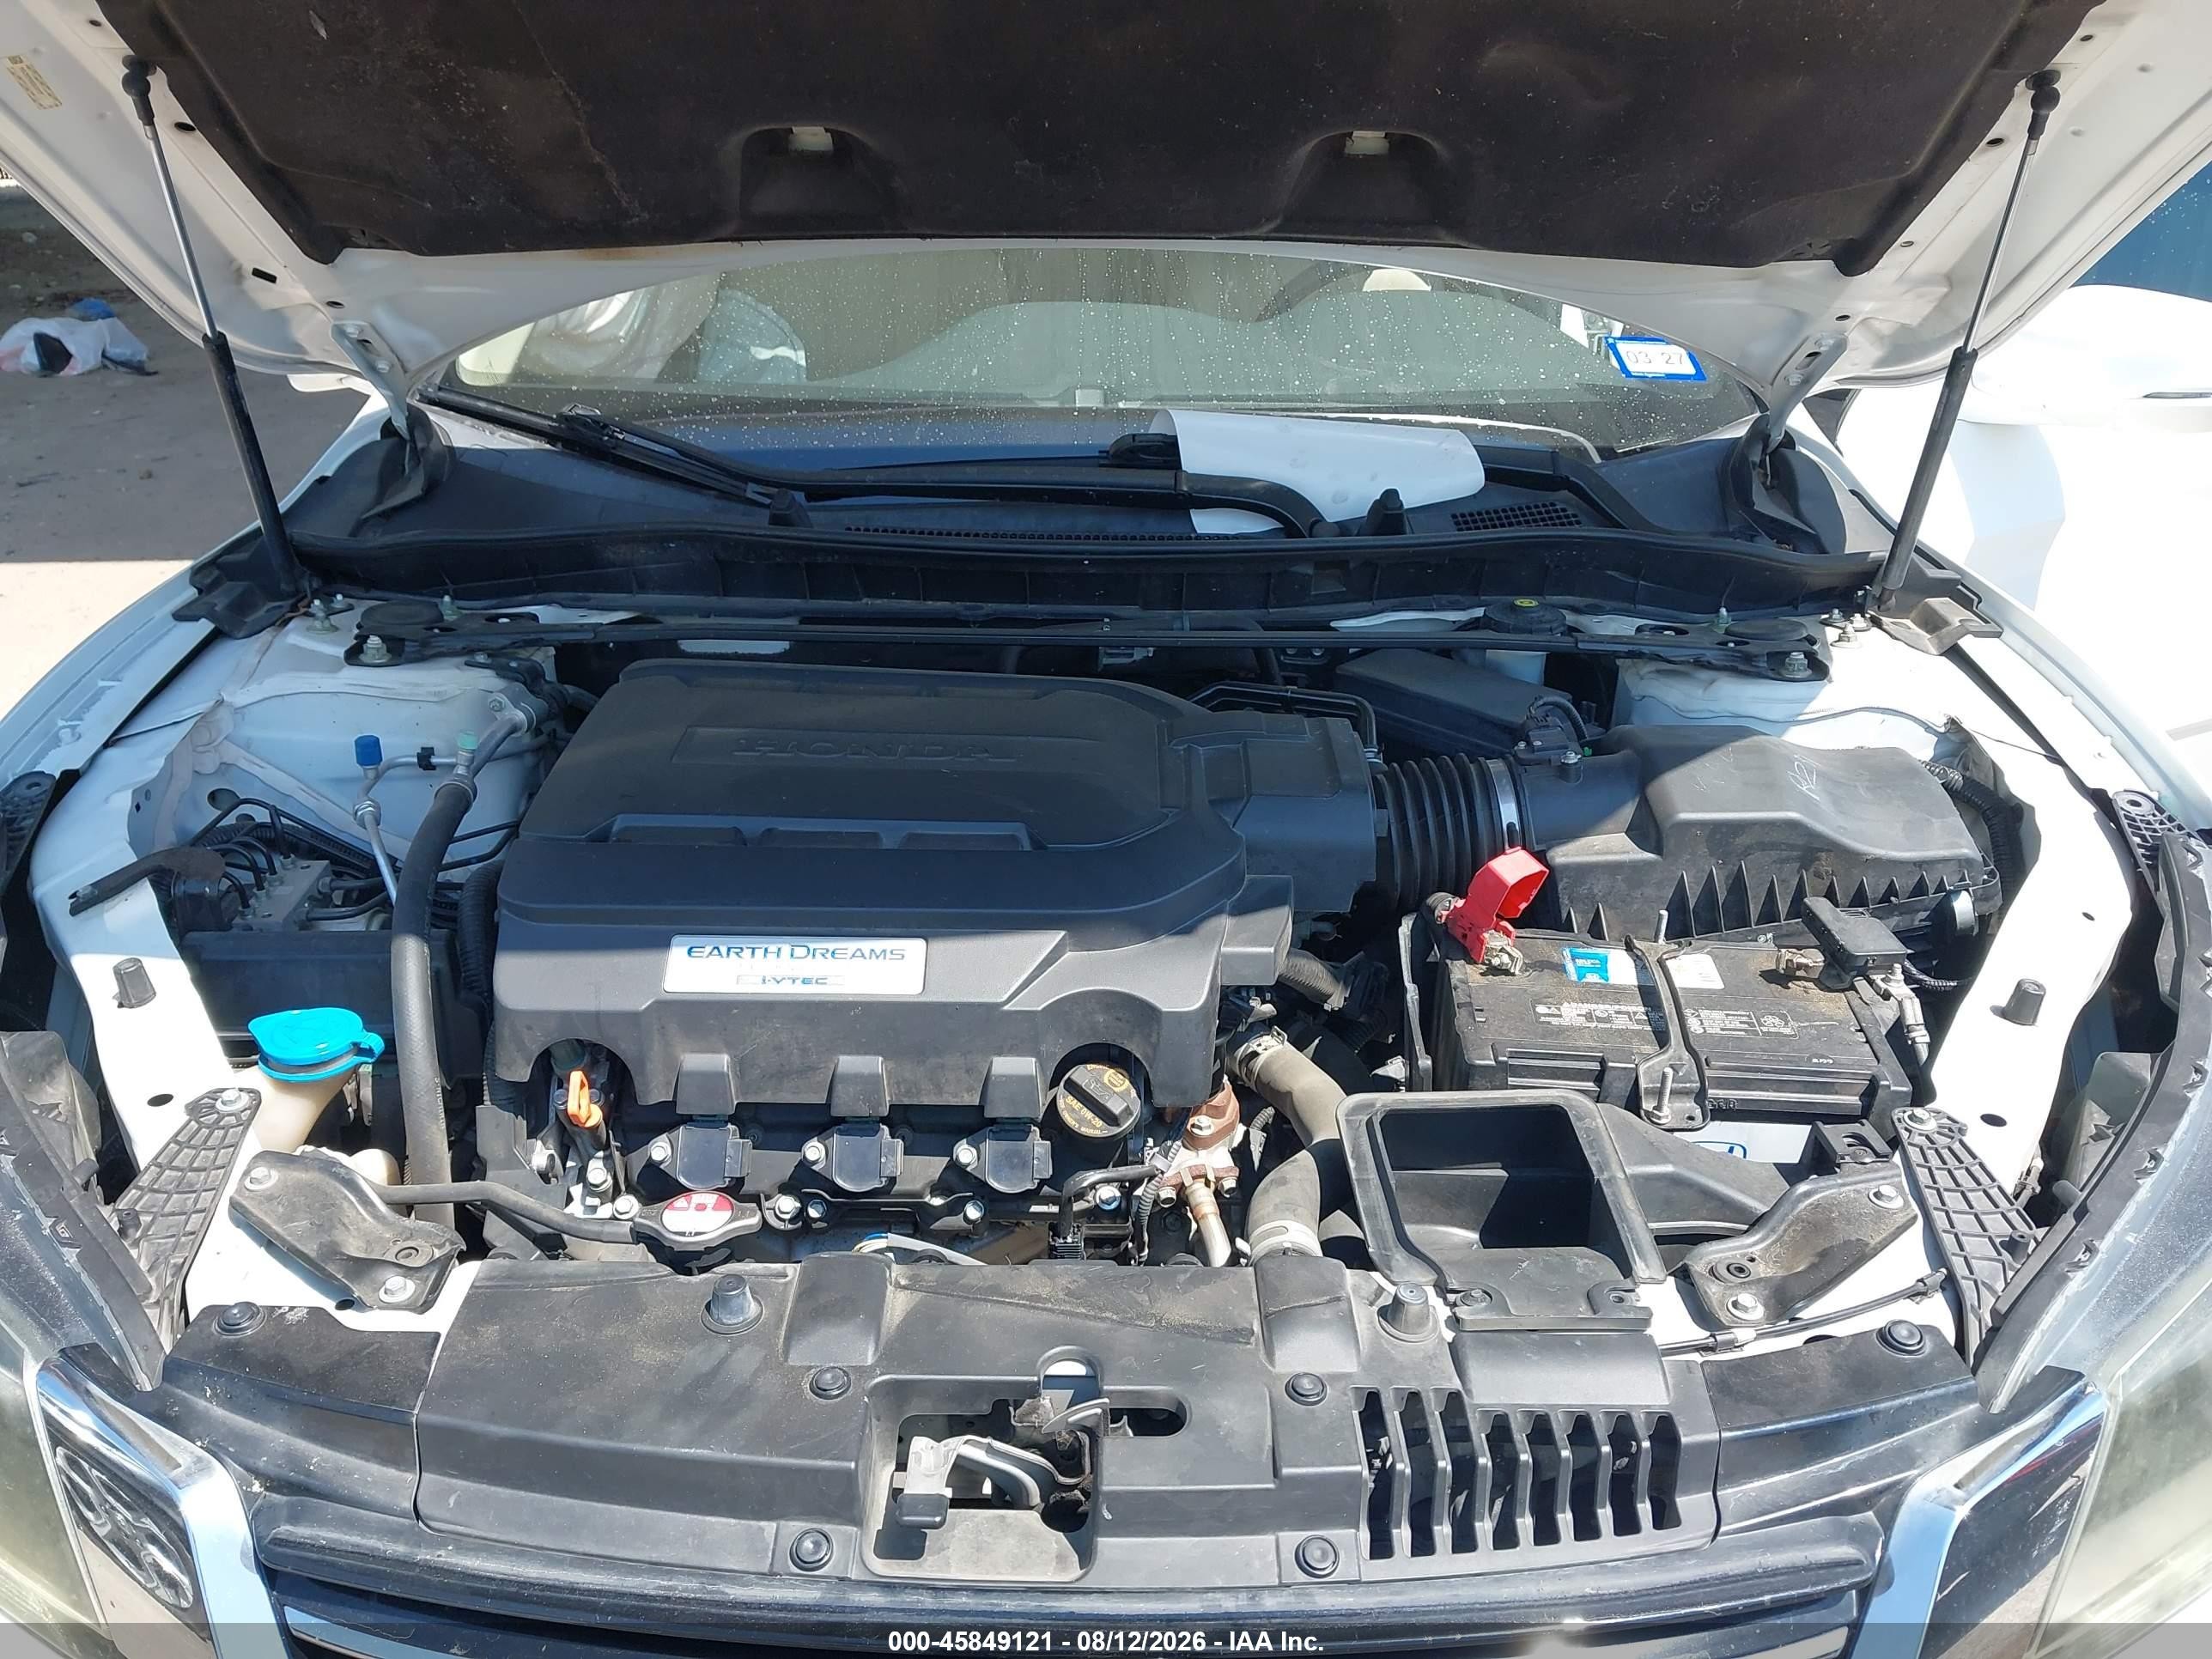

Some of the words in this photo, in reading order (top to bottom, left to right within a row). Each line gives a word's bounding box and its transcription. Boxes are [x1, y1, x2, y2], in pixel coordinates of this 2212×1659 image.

[1626, 350, 1652, 364] 03
[1661, 352, 1684, 365] 27
[732, 739, 1023, 763] HONDA
[686, 945, 781, 959] EARTH
[1065, 1095, 1084, 1111] SAE
[1080, 1108, 1103, 1128] 0W-20
